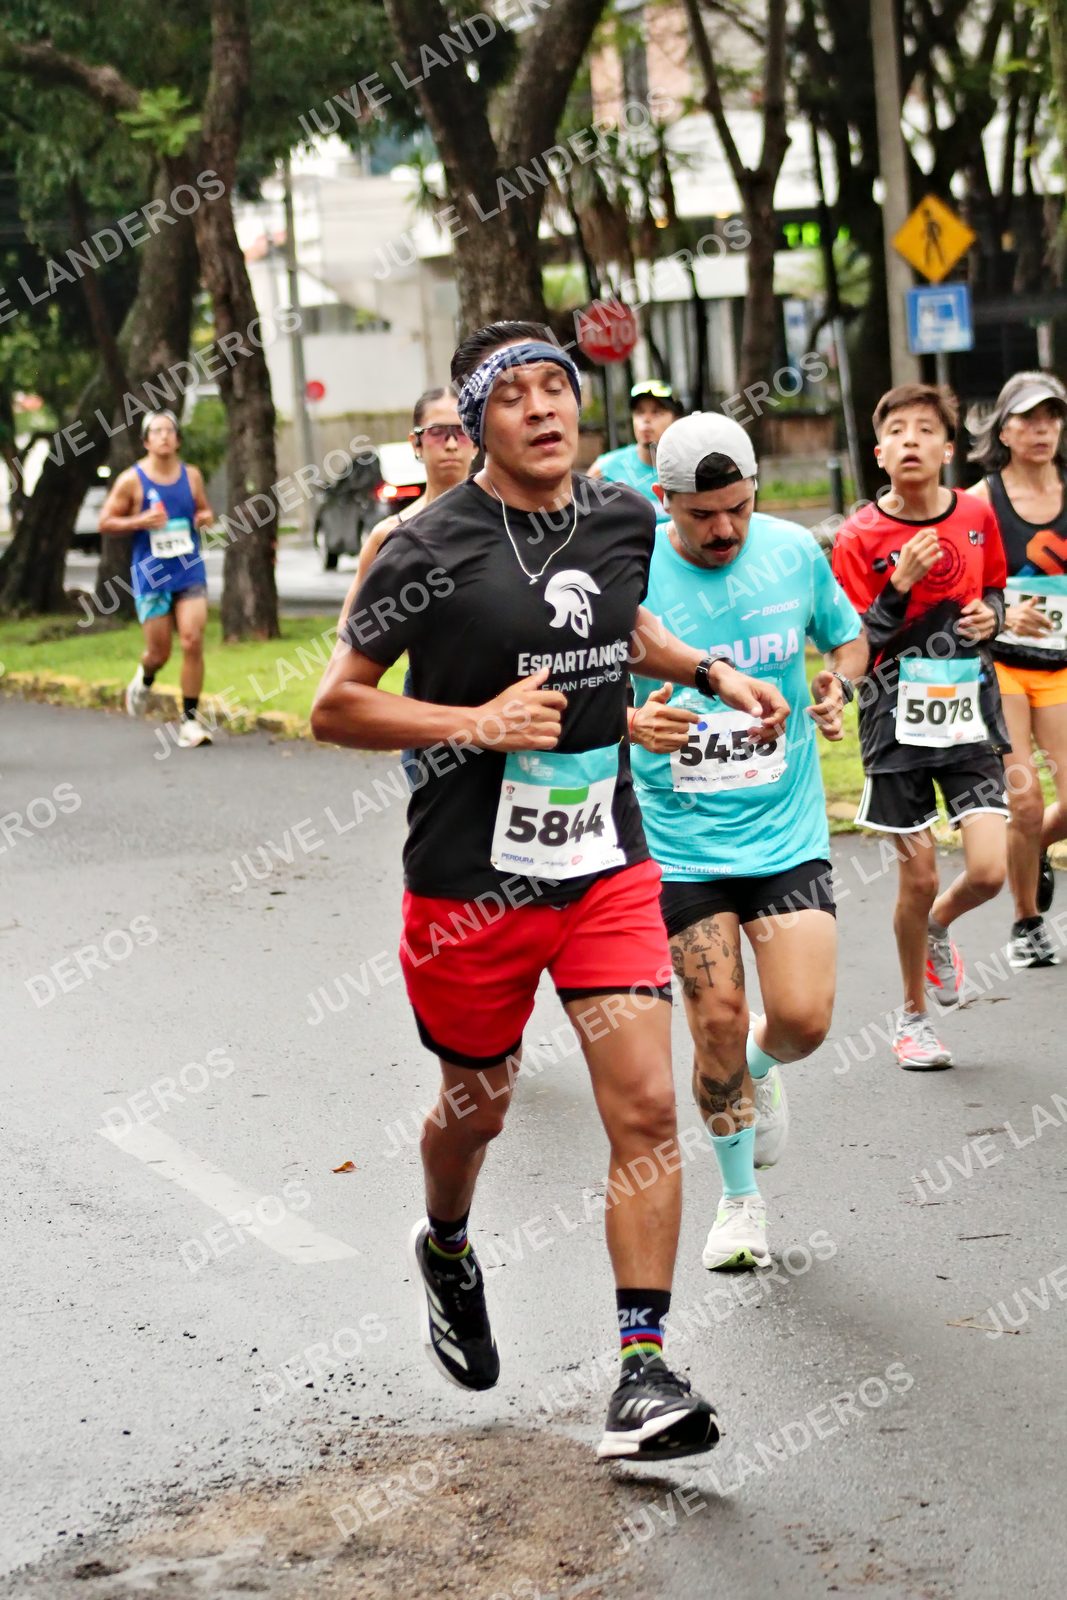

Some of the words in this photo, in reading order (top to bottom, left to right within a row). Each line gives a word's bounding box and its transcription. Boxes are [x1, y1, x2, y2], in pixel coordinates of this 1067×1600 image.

[761, 599, 800, 616] BROOKS
[517, 641, 628, 677] ESPARTANOS
[709, 627, 799, 669] DURA
[552, 680, 578, 692] DAN
[905, 697, 974, 725] 5078
[504, 802, 606, 847] 5844
[501, 852, 535, 865] PERDURA
